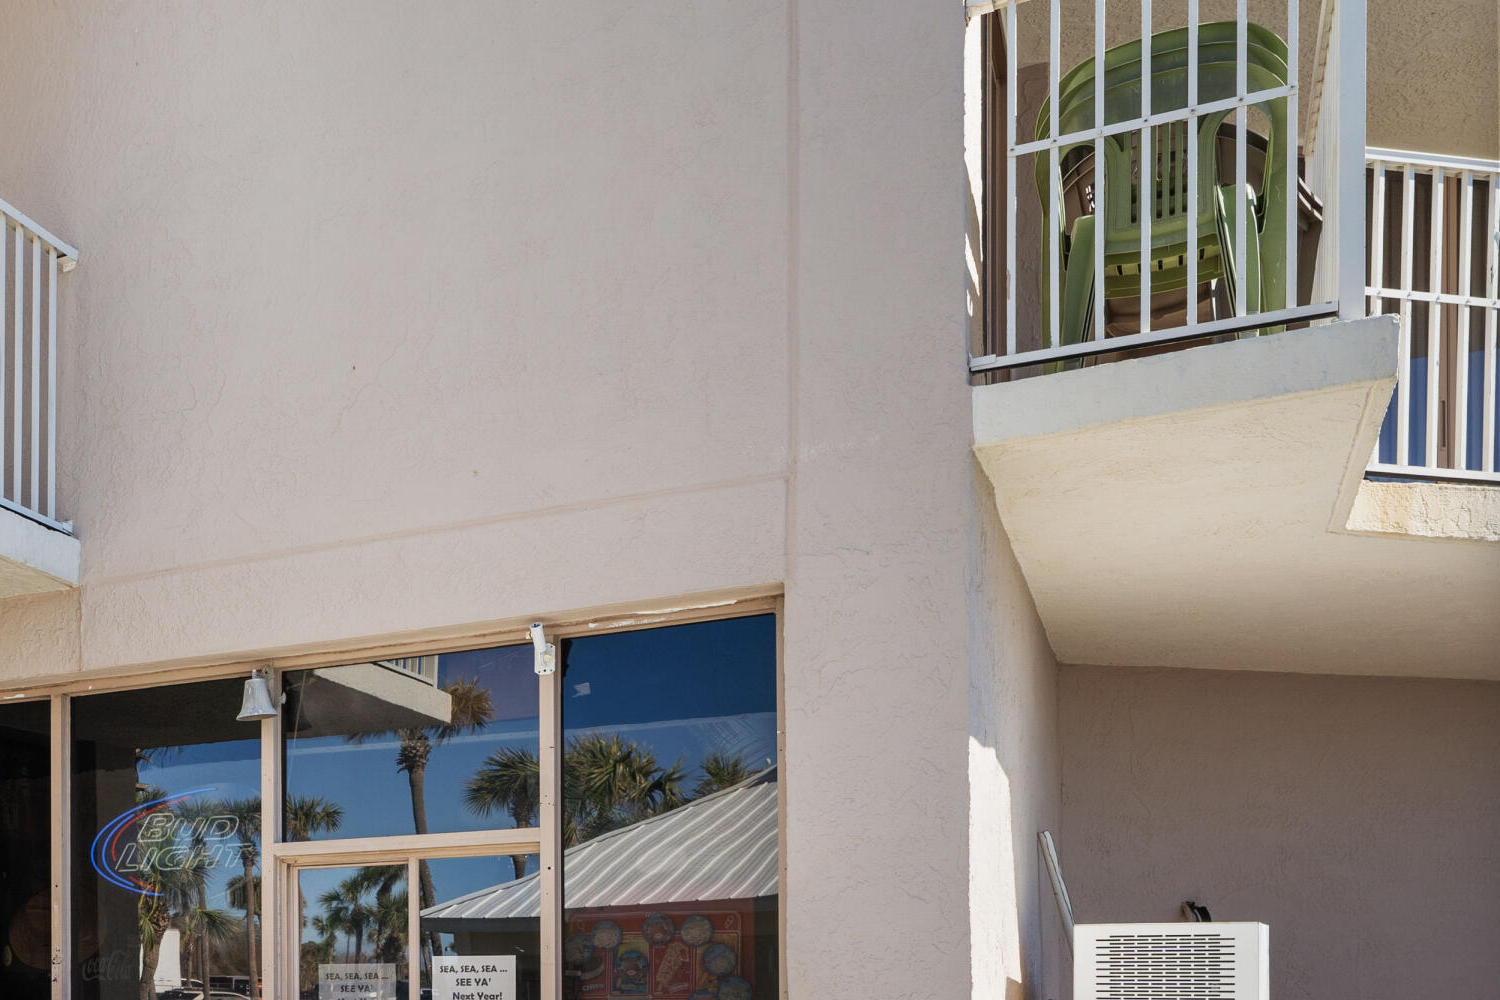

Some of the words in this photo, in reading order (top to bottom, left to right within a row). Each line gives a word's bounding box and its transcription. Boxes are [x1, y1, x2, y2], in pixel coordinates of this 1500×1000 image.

[137, 812, 240, 843] BUD
[114, 842, 252, 873] LIGHT
[440, 965, 458, 974] SEA,
[460, 965, 479, 974] SEA,
[481, 965, 497, 973] SEA
[325, 973, 343, 981] SEA,
[344, 973, 362, 981] SEA,
[455, 978, 472, 987] SEE
[474, 978, 492, 987] YA'
[340, 984, 356, 993] SEE
[452, 991, 475, 1000] Next
[476, 991, 503, 1000] Year!
